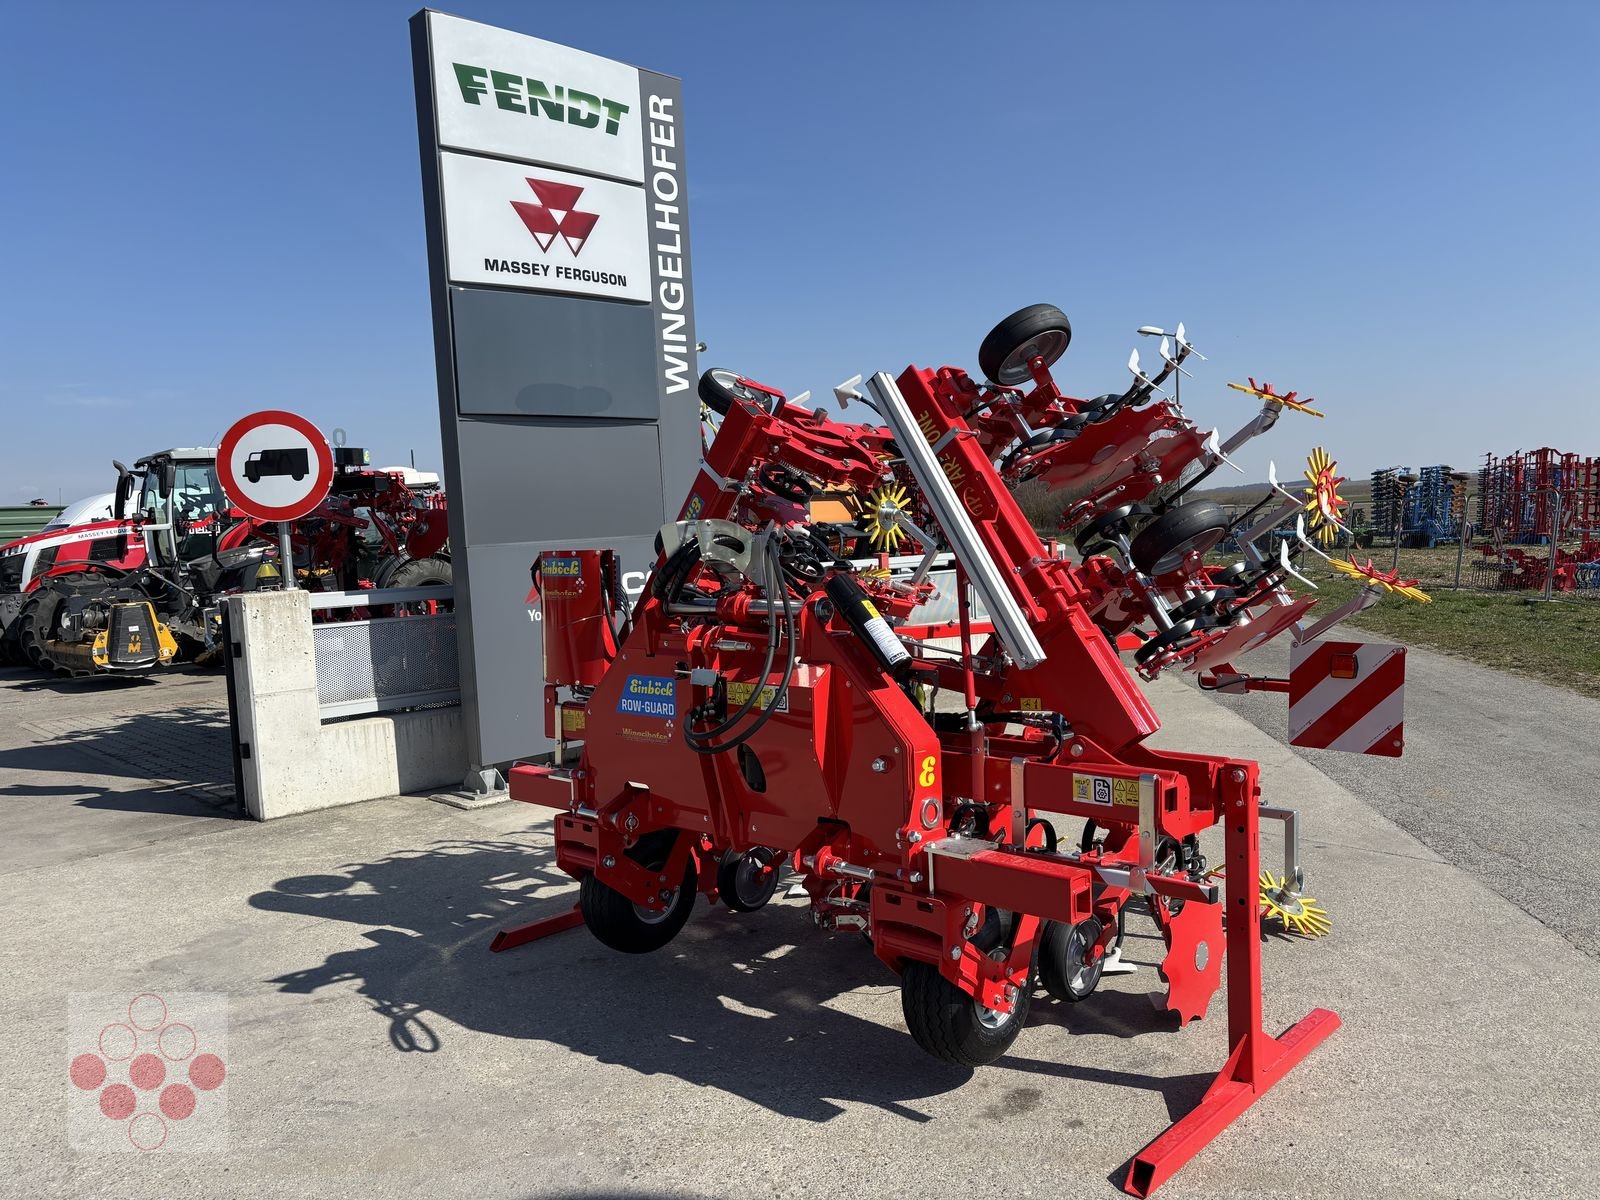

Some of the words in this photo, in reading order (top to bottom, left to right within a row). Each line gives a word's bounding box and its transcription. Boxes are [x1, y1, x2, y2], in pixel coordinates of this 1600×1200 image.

[452, 62, 629, 136] FENDT
[648, 94, 690, 394] WINGELHOFER
[484, 258, 551, 277] MASSEY
[555, 266, 627, 287] FERGUSON
[630, 679, 673, 697] Einböck
[621, 699, 675, 716] ROW-GUARD
